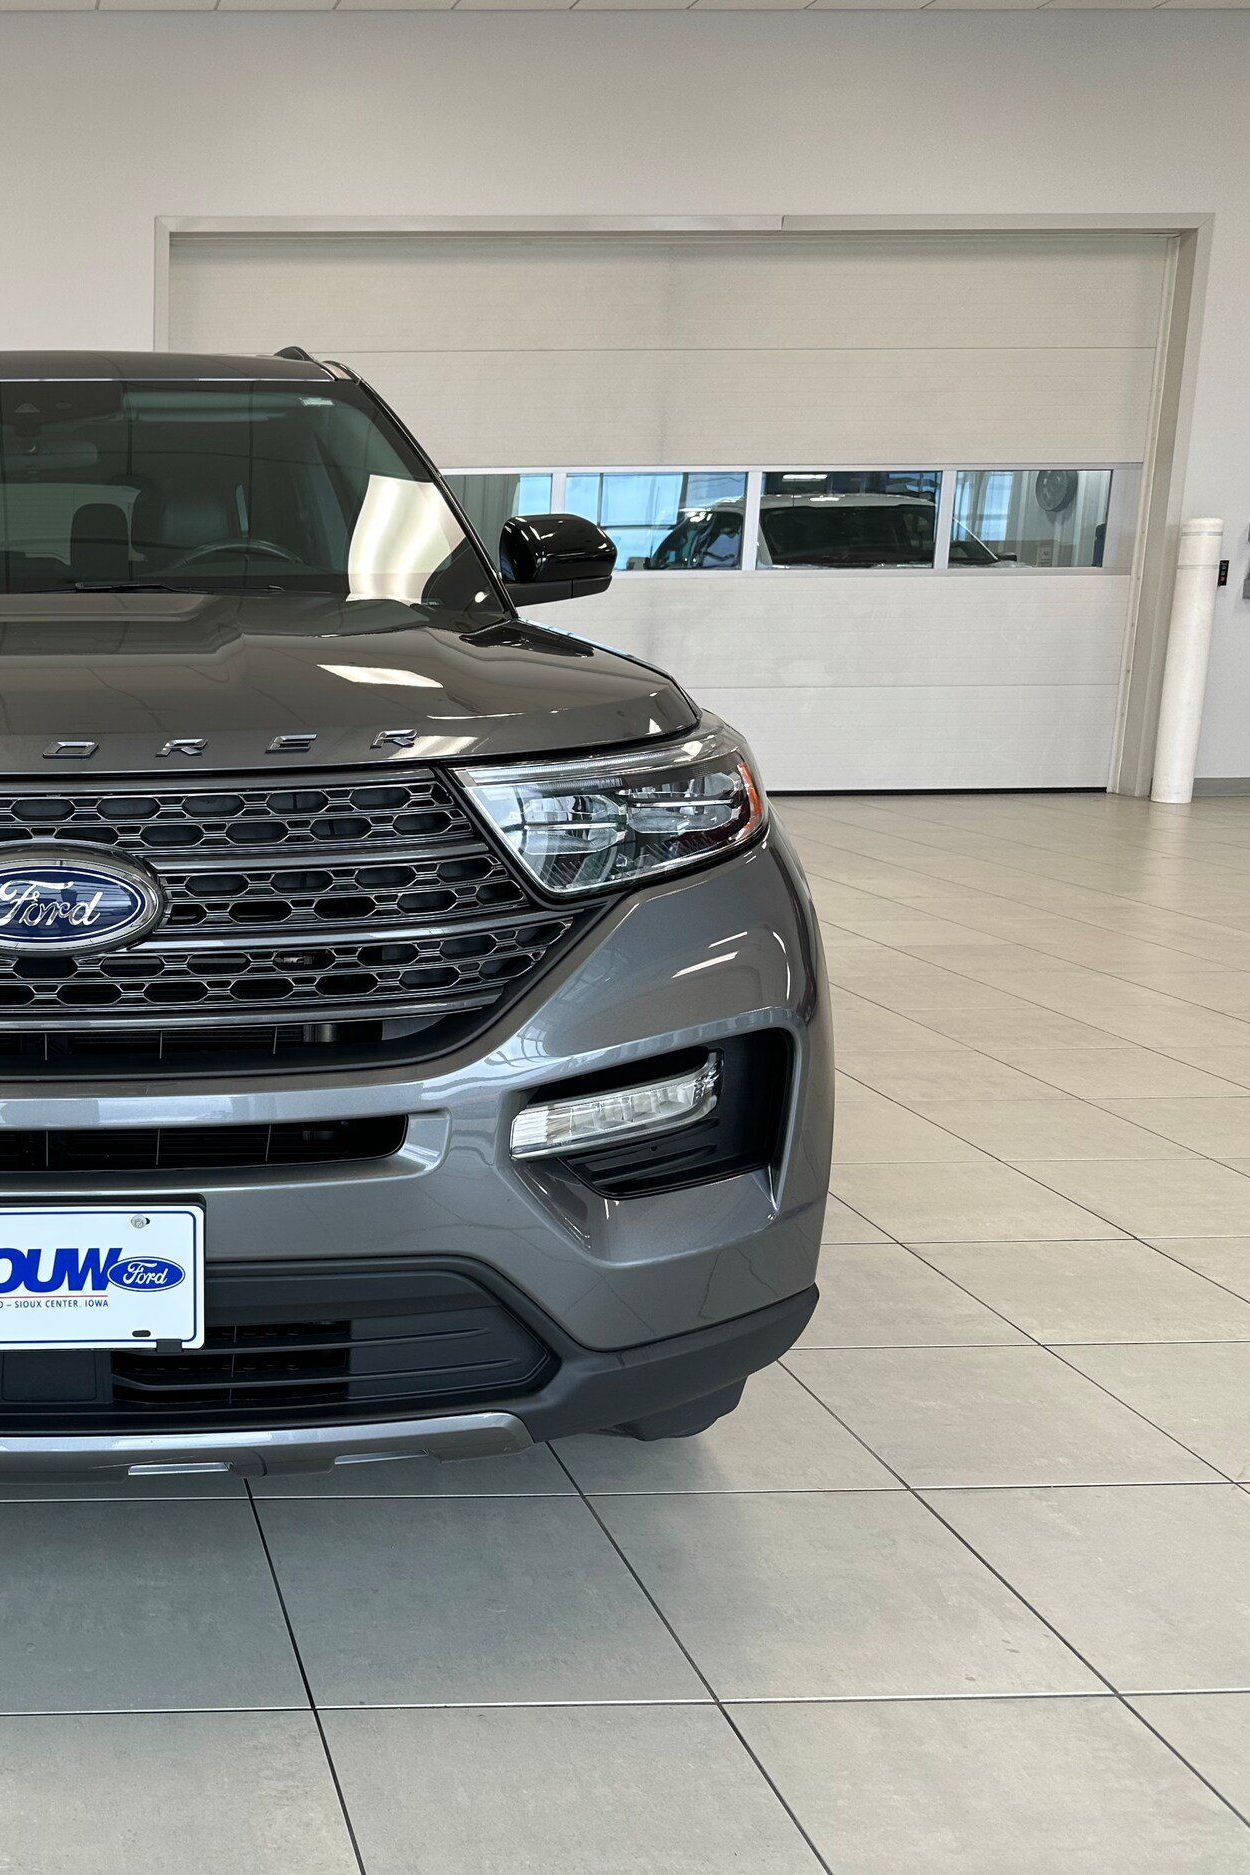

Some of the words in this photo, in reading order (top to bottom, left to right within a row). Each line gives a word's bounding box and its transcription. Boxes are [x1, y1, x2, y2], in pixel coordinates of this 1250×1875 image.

[123, 1261, 169, 1286] Ford
[14, 1300, 42, 1309] SIOUX
[85, 1299, 109, 1308] IOWA
